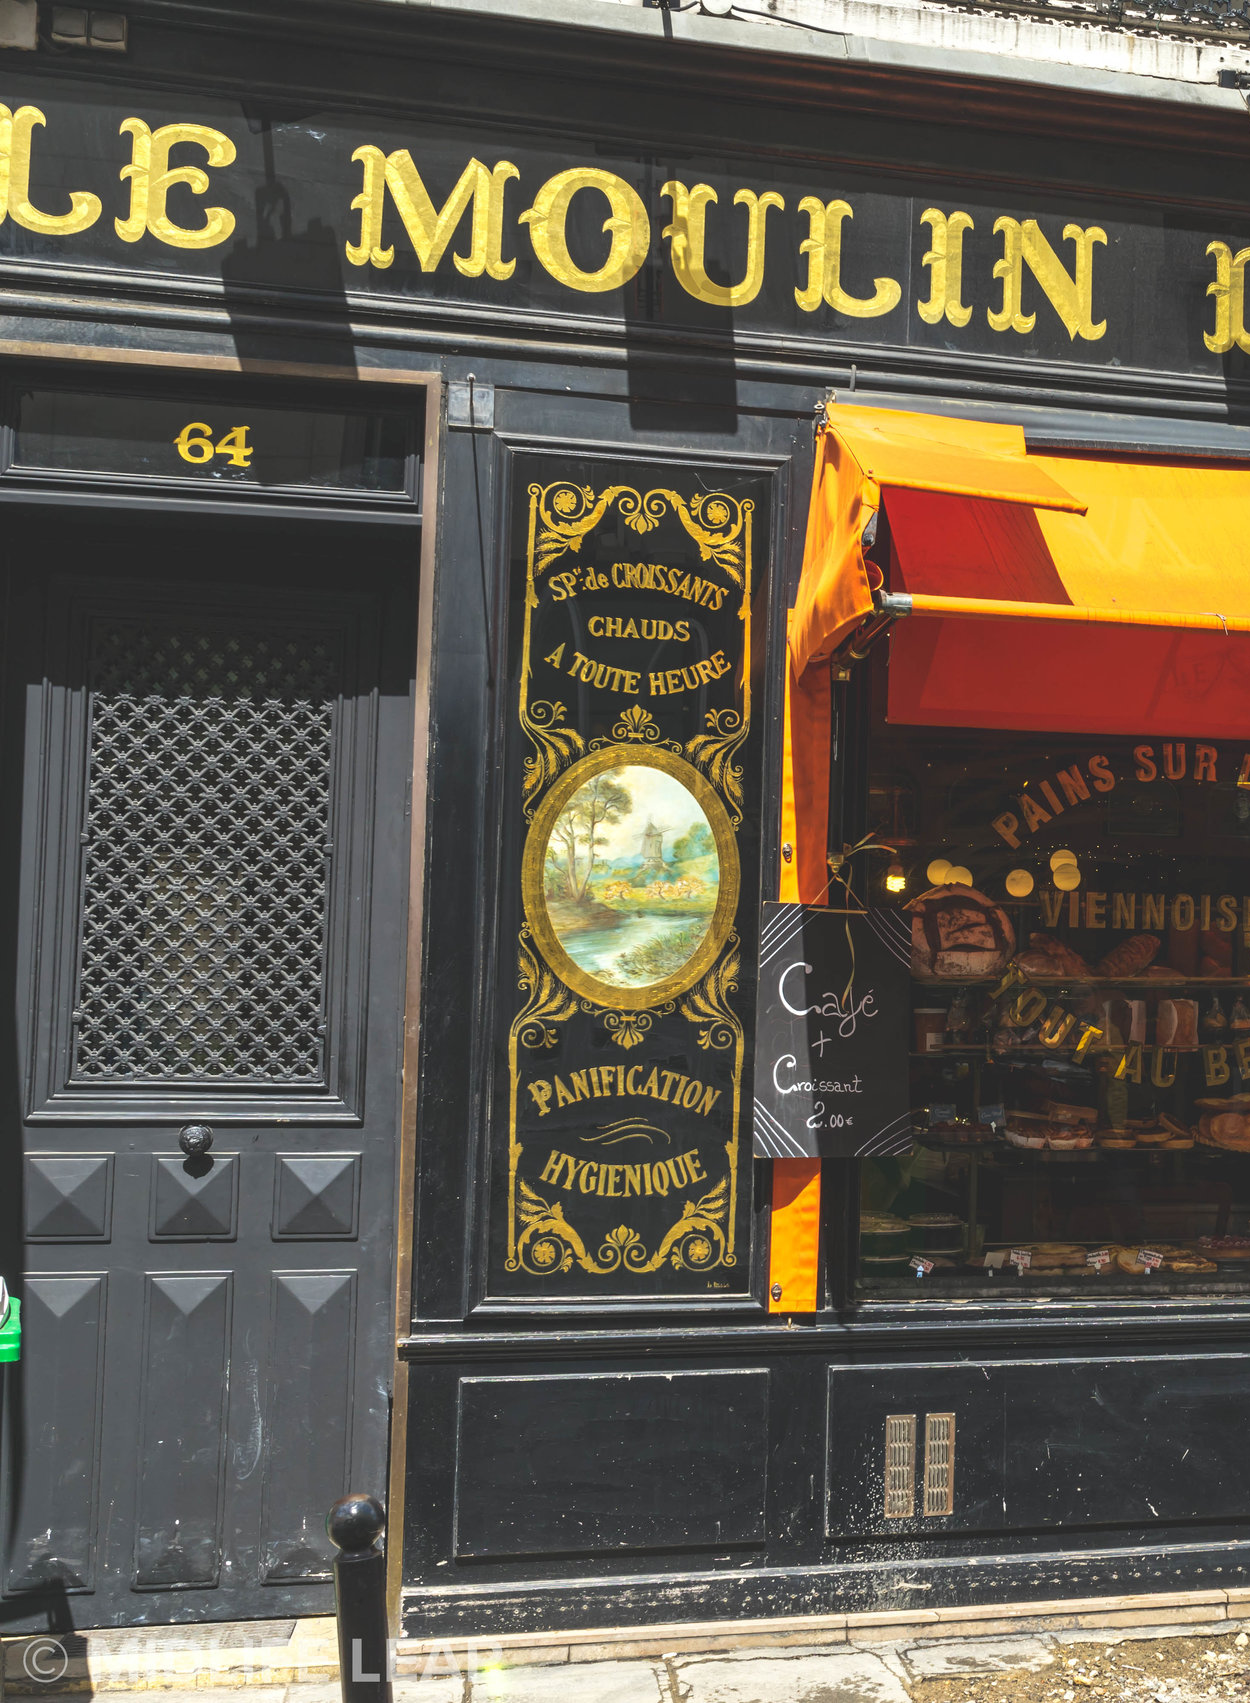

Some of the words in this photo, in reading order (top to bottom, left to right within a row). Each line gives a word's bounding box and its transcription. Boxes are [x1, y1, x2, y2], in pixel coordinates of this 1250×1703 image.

[0, 104, 238, 250] LE
[345, 144, 1108, 341] MOULIN
[174, 422, 254, 467] 64
[585, 567, 610, 591] de
[611, 562, 729, 611] CROISSANTS
[588, 616, 690, 641] CHAUDS
[544, 642, 566, 669] A
[567, 651, 641, 695] TOUTE
[648, 650, 731, 696] HEURE
[991, 754, 1117, 849] PAINS
[1133, 742, 1219, 783] SUR
[778, 962, 879, 1038] Café
[988, 959, 1104, 1064] TOUT
[1114, 1039, 1180, 1088] AU
[527, 1065, 722, 1117] PANIFICATION
[773, 1054, 863, 1094] Croissant
[539, 1148, 708, 1197] HYGIENIQUE
